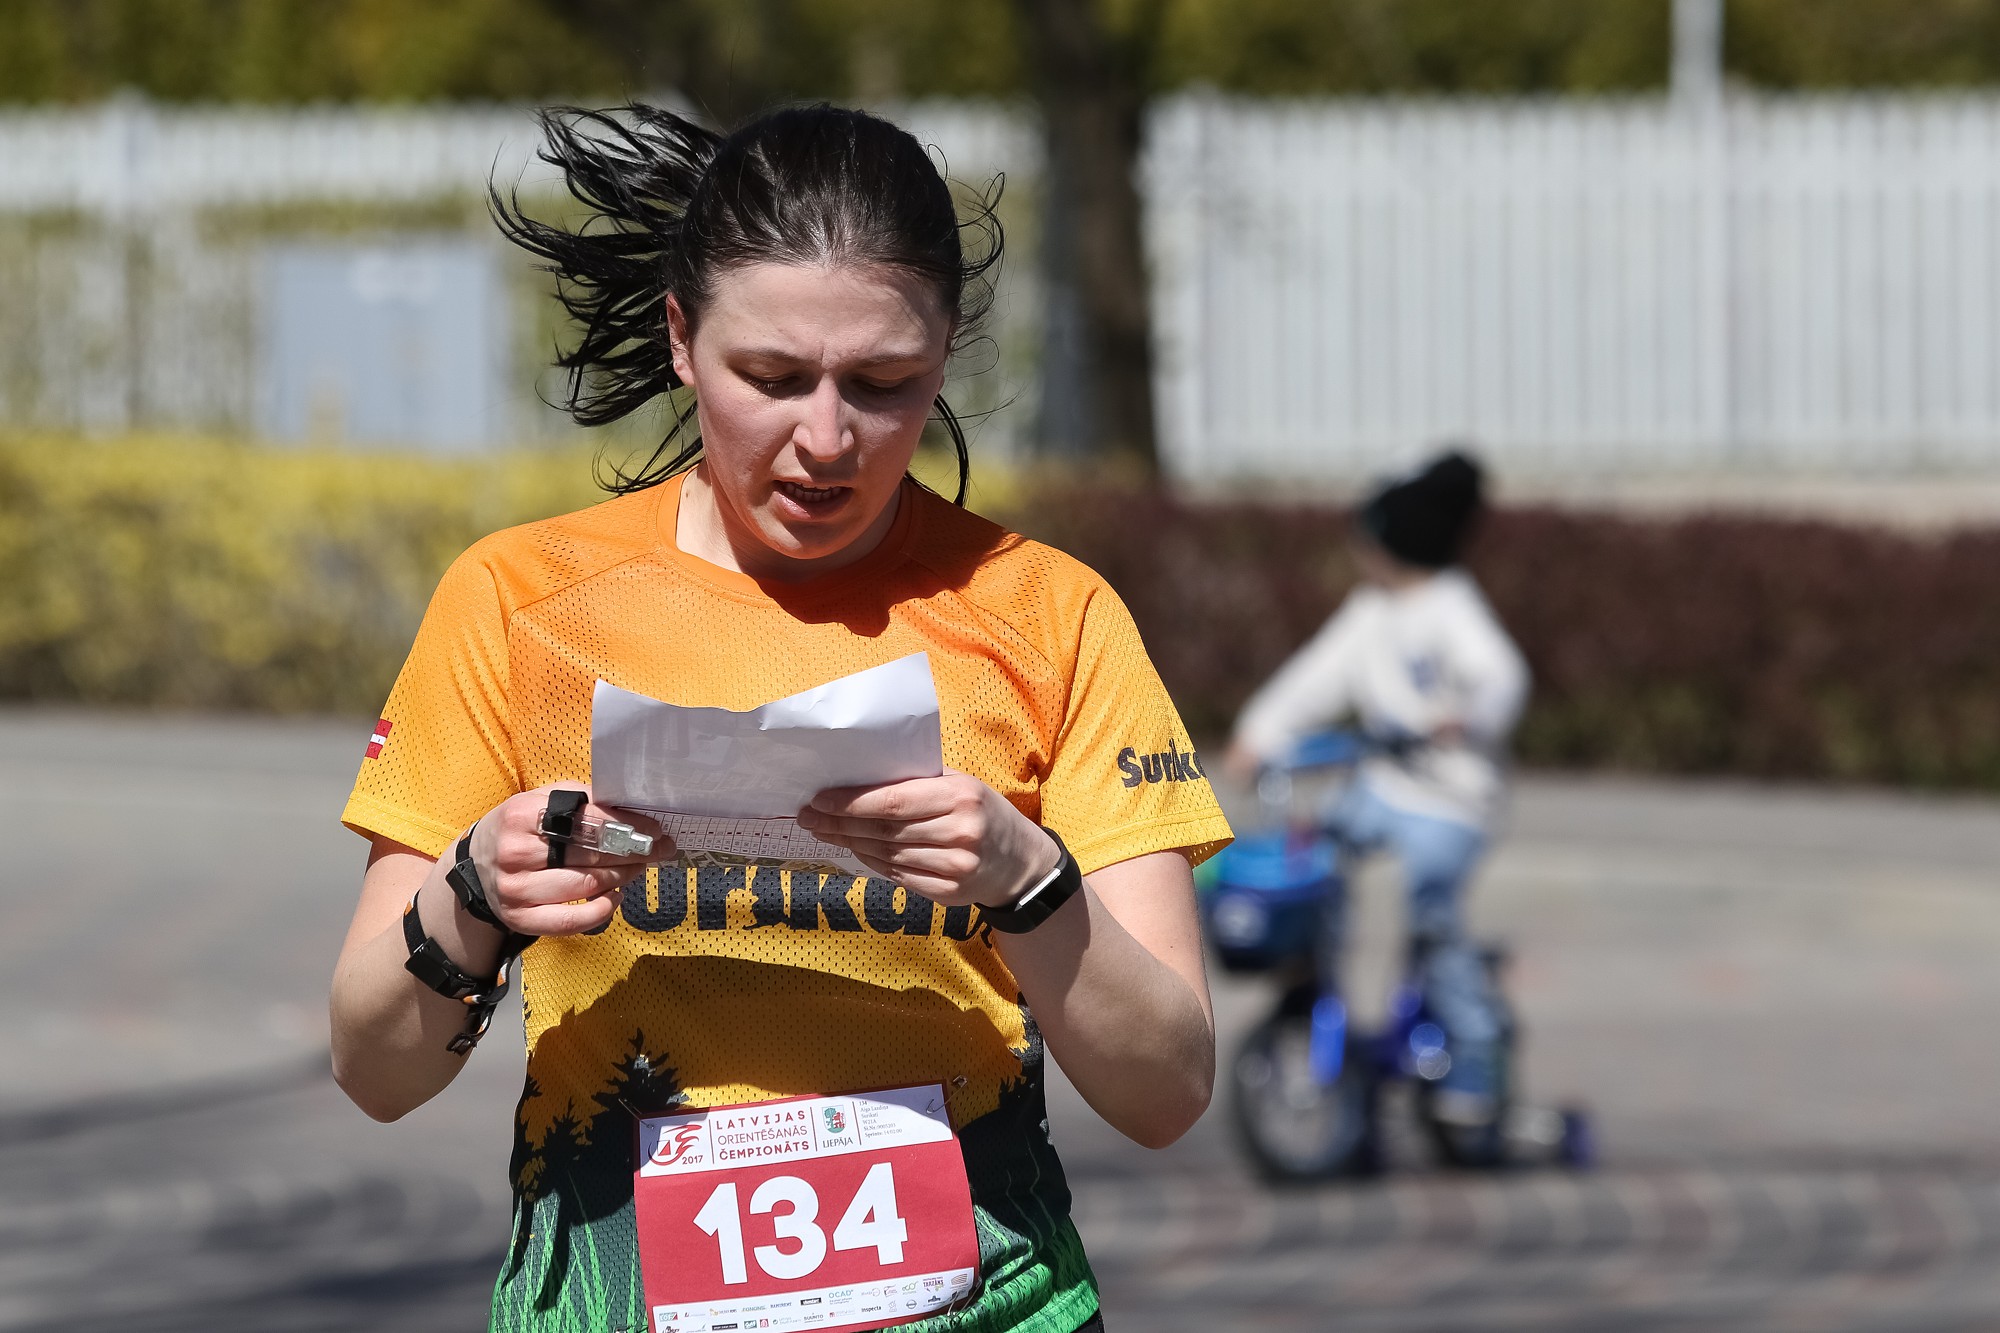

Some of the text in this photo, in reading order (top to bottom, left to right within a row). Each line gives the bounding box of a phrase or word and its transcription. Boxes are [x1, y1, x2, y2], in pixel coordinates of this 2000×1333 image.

[716, 1110, 805, 1130] LATVIJAS
[717, 1125, 808, 1146] ORIENTĒŠANĀS
[822, 1136, 854, 1149] LIEPĀJA
[681, 1154, 704, 1165] 2017
[719, 1140, 810, 1161] ČEMPIONĀTS
[692, 1161, 909, 1286] 134
